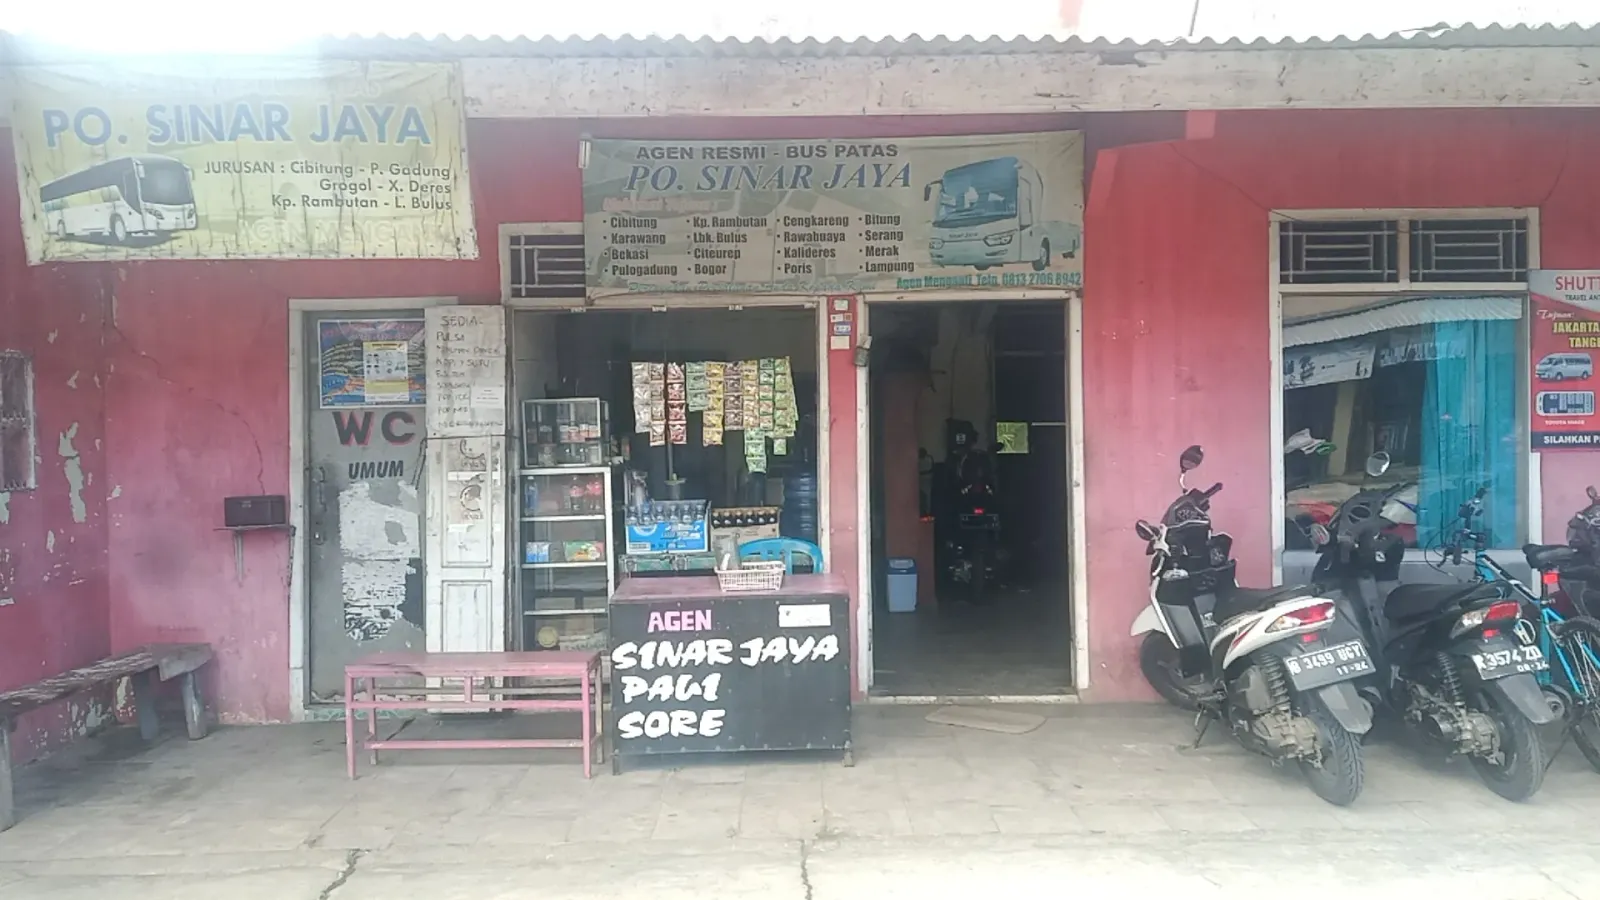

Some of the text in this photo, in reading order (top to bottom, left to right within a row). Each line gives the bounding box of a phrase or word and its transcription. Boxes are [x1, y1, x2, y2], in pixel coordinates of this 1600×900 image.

[42, 104, 431, 147] PO. SINAR JAYA
[636, 147, 693, 160] AGEN
[702, 146, 766, 159] RESMI
[786, 145, 827, 158] BUS
[835, 144, 898, 157] PATAS
[204, 161, 275, 174] JURUSAN
[290, 161, 353, 177] Cibitung
[370, 163, 383, 175] P.
[389, 163, 450, 180] Gadung
[624, 162, 911, 191] PO. SINAR JAYA
[320, 179, 372, 194] Grogol
[388, 181, 404, 192] X.
[409, 180, 451, 193] Deres
[271, 195, 296, 210] Kp.
[302, 195, 378, 209] Rambutan
[395, 196, 406, 209] L.
[411, 197, 452, 210] Bulus
[610, 217, 658, 229] Cibitung
[693, 217, 767, 230] Kp. Rambutan
[783, 215, 849, 228] Cengkareng
[865, 214, 900, 226] Bitung
[611, 233, 667, 245] Karawang
[717, 232, 748, 243] Bulus
[784, 231, 846, 244] Rawabuaya
[865, 230, 904, 242] Serang
[612, 249, 649, 260] Bekasi
[784, 247, 836, 259] Kalideres
[865, 246, 899, 257] Merak
[612, 265, 678, 277] Pulogadung
[694, 264, 727, 276] Bogor
[784, 263, 812, 274] Poris
[865, 261, 915, 274] Lampung
[1553, 322, 1600, 333] JAKARTA
[436, 331, 465, 343] PULSA
[1544, 434, 1591, 445] SILAHKAN
[349, 460, 404, 480] UMUM
[648, 609, 712, 633] AGEN
[611, 634, 839, 670] SINAR JAYA
[1487, 648, 1523, 667] 3574
[1302, 652, 1336, 670] 3499
[617, 709, 726, 739] SORE
